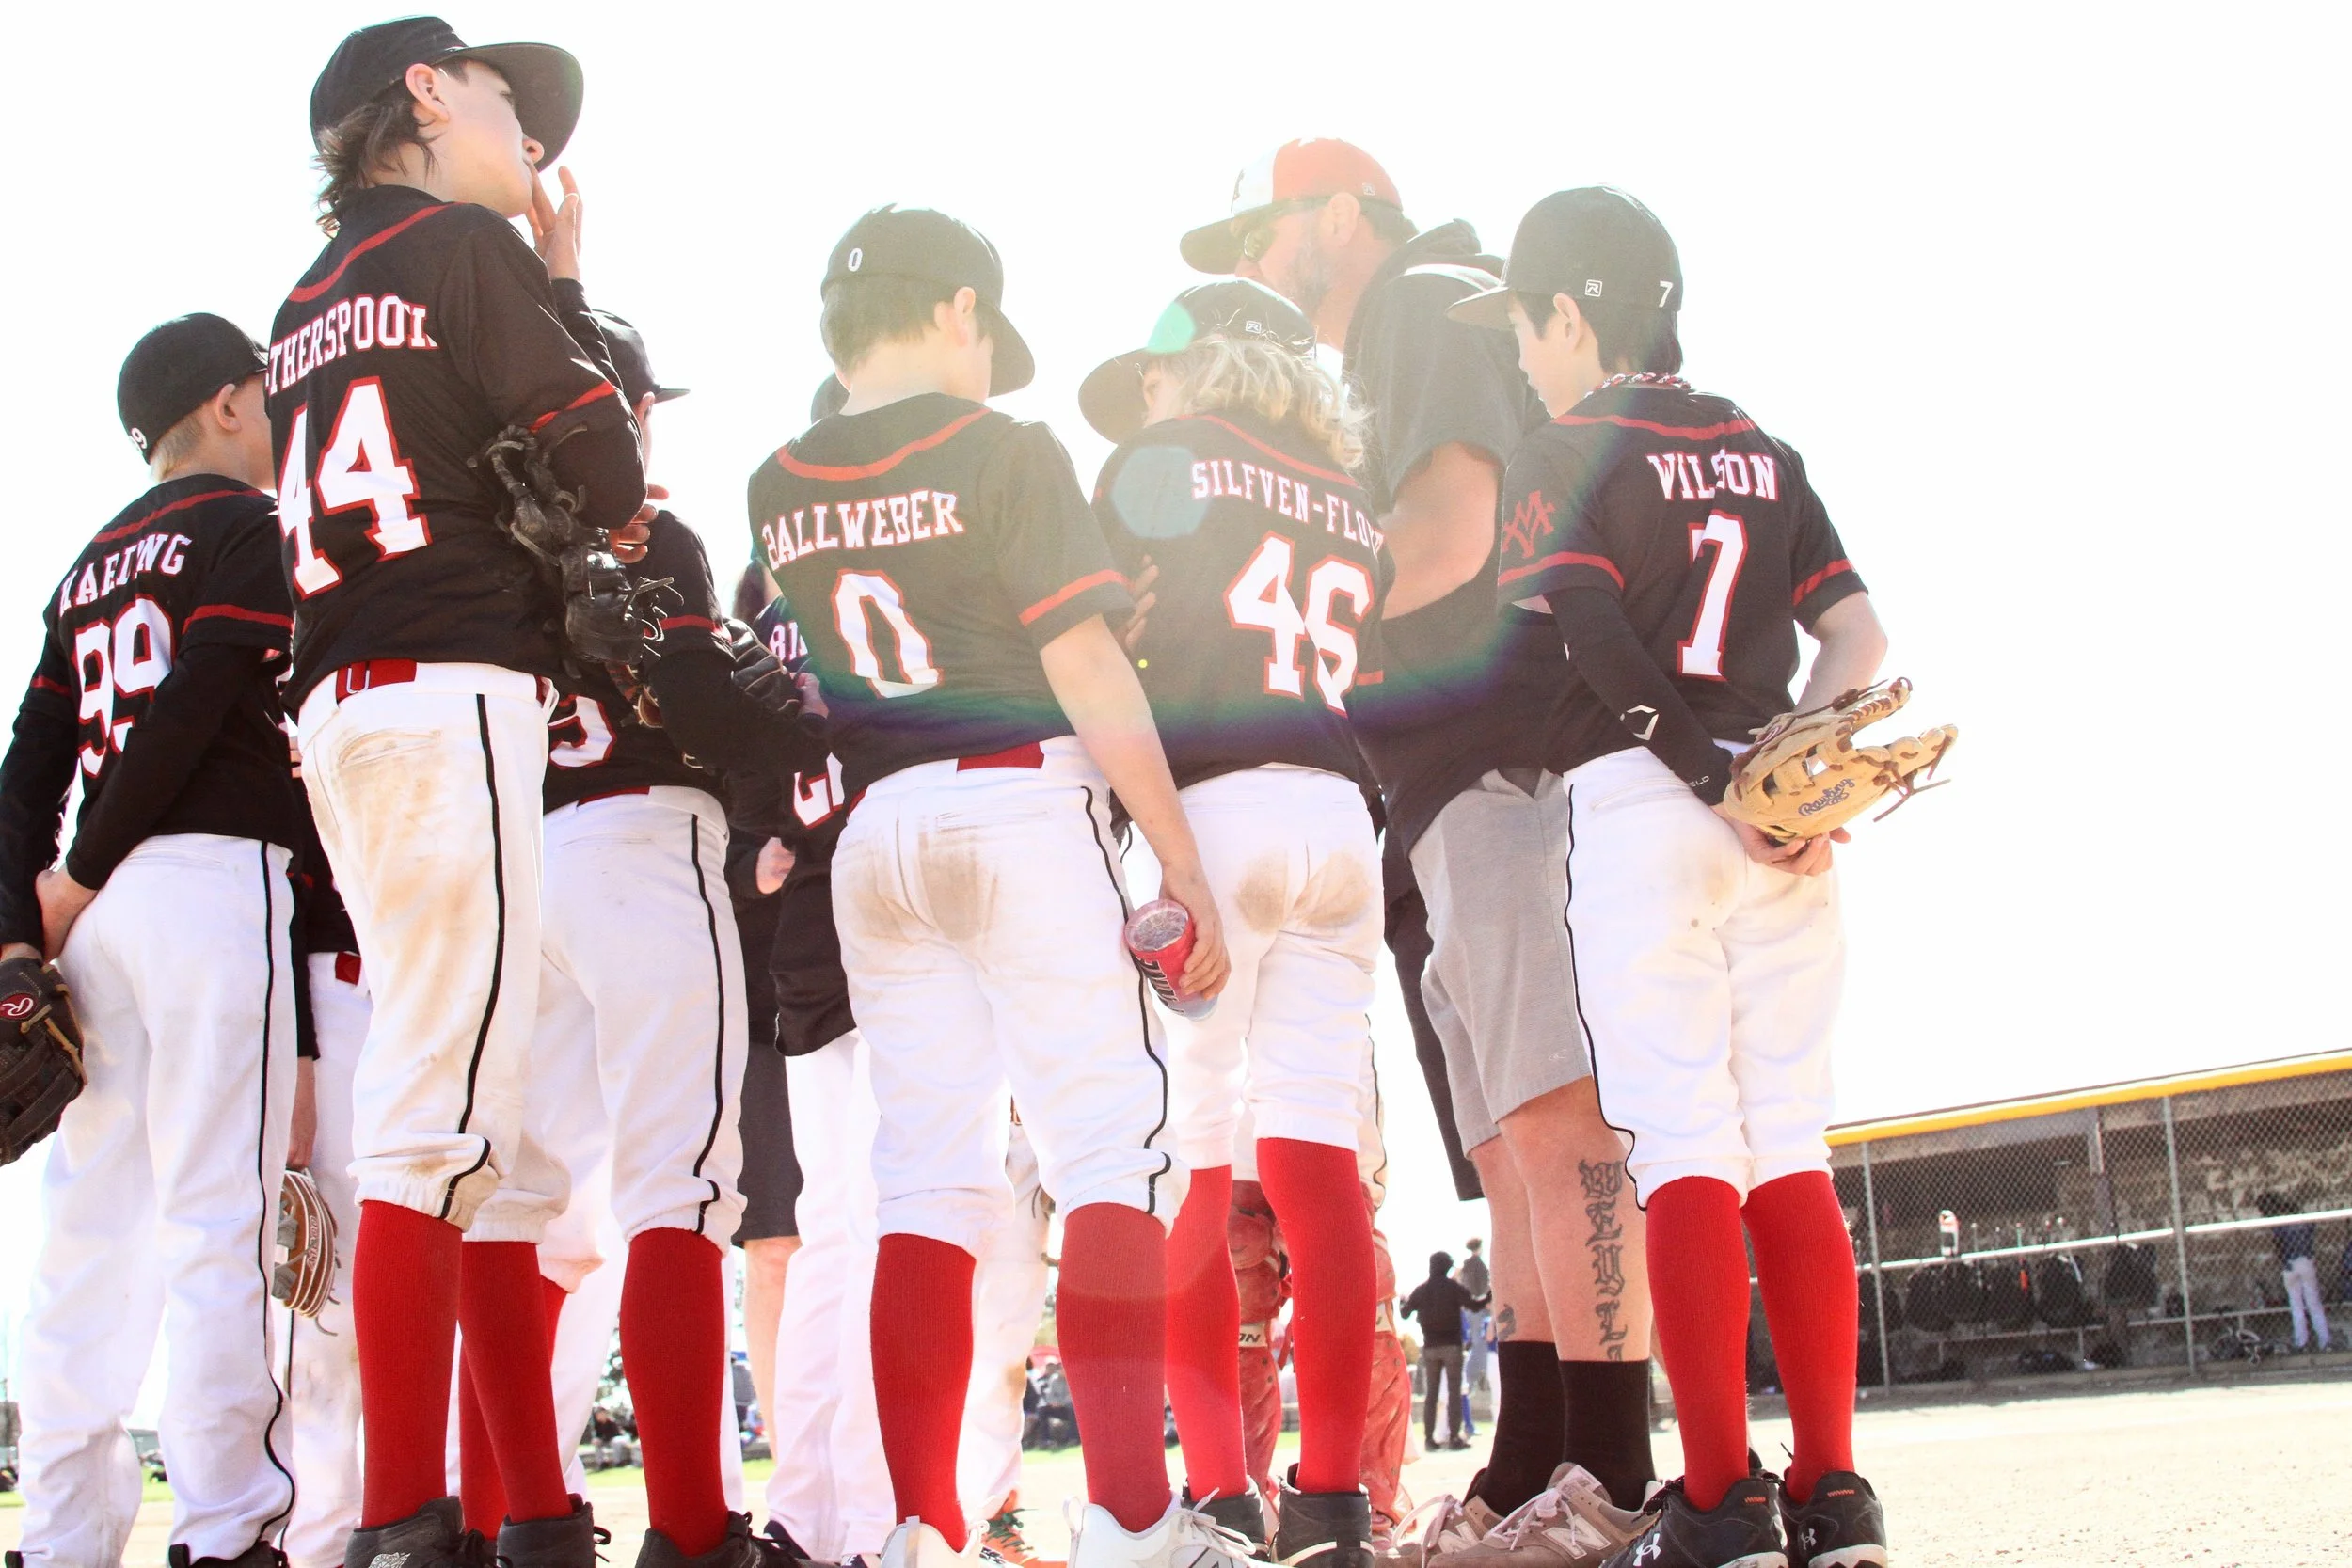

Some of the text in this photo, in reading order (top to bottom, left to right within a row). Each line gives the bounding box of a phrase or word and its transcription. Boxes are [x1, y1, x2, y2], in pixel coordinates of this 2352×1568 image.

[265, 293, 439, 397] THERSPOO
[1659, 280, 1673, 308] 7
[277, 375, 434, 601] 44
[1646, 449, 1779, 501] WILSON
[831, 568, 944, 700] 0
[1221, 530, 1374, 720] 46
[1677, 509, 1748, 682] 7
[72, 594, 176, 779] 99
